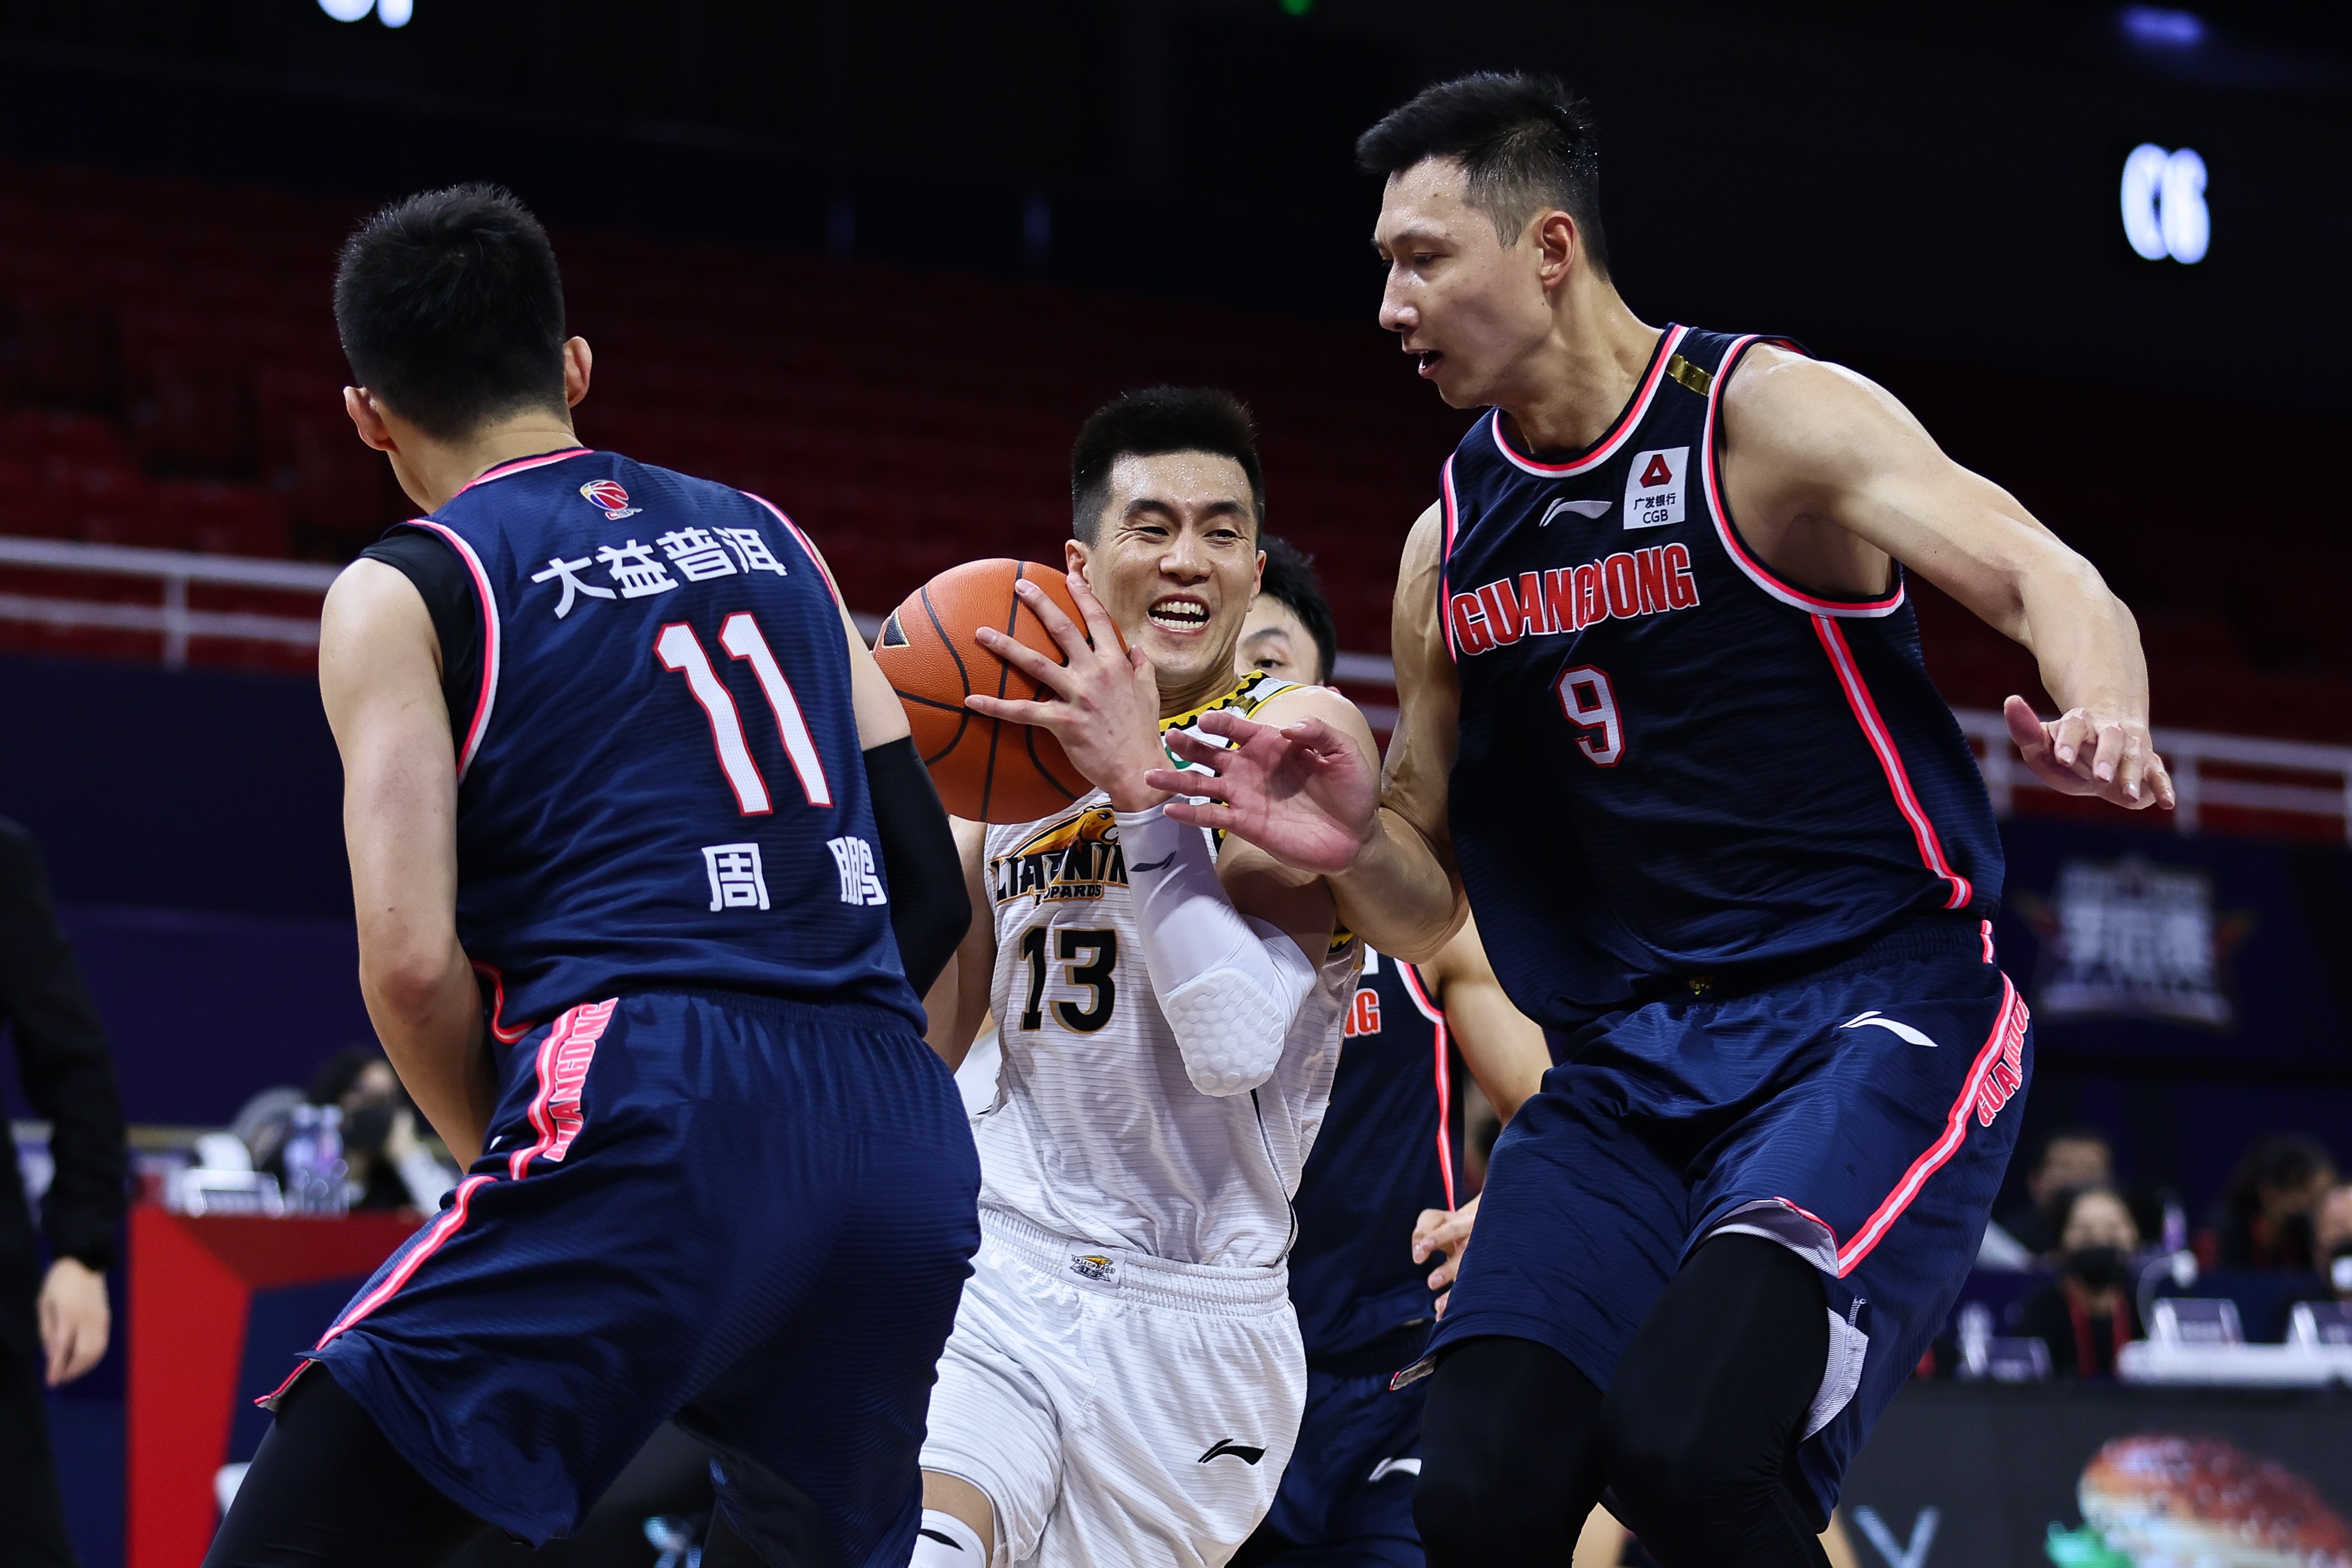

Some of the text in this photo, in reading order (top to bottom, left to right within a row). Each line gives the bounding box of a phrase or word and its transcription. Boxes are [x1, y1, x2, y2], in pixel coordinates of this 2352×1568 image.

[1633, 492, 1676, 510] 广发银行
[1642, 509, 1669, 524] CGB
[531, 527, 787, 619] 大益普洱
[654, 611, 833, 816] 11
[1555, 664, 1626, 767] 9
[1034, 884, 1102, 907] LPARDS
[1019, 926, 1119, 1034] 13
[543, 997, 619, 1162] GUANGDNG
